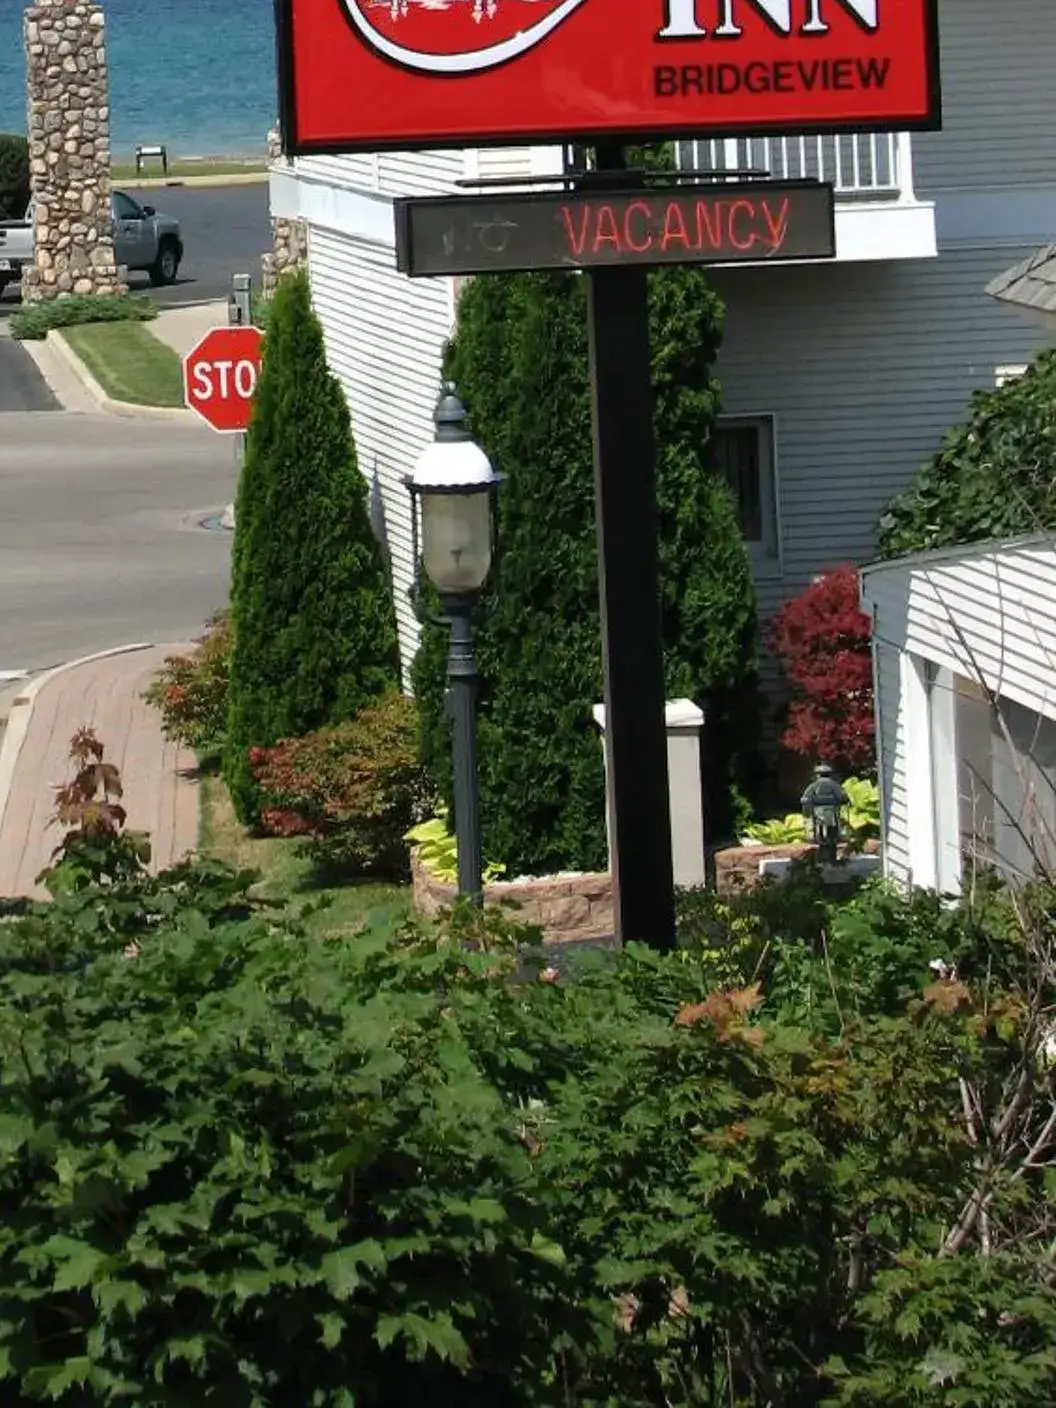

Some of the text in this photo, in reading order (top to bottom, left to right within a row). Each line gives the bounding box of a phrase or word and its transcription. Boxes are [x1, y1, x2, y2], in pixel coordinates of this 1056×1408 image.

[653, 57, 891, 97] BRIDGEVIEW
[559, 197, 789, 257] VACANCY
[192, 359, 262, 401] STO
